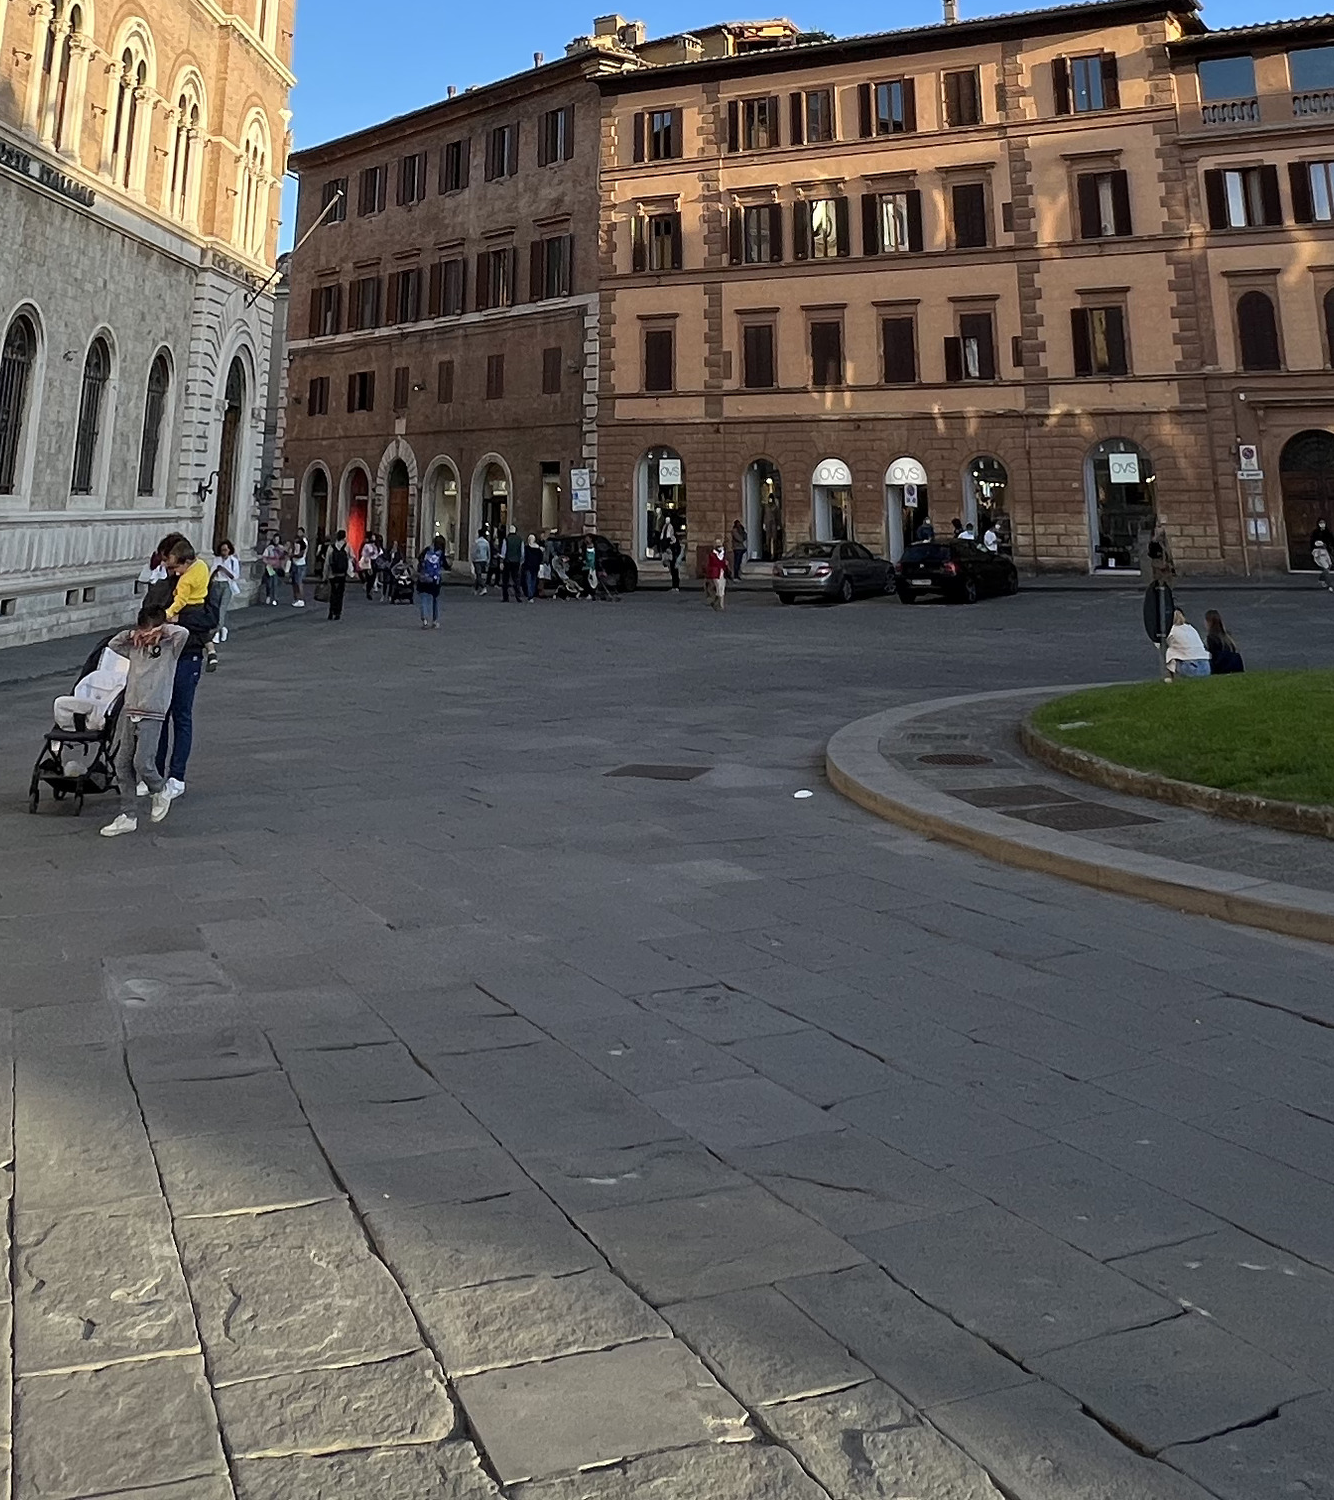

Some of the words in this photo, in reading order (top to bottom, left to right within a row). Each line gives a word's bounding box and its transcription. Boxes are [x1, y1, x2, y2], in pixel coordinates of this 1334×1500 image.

[39, 164, 96, 207] ITALIANE
[660, 466, 680, 478] OVS
[820, 467, 846, 481] OVS
[892, 466, 919, 481] OVS
[1111, 462, 1137, 474] OVS
